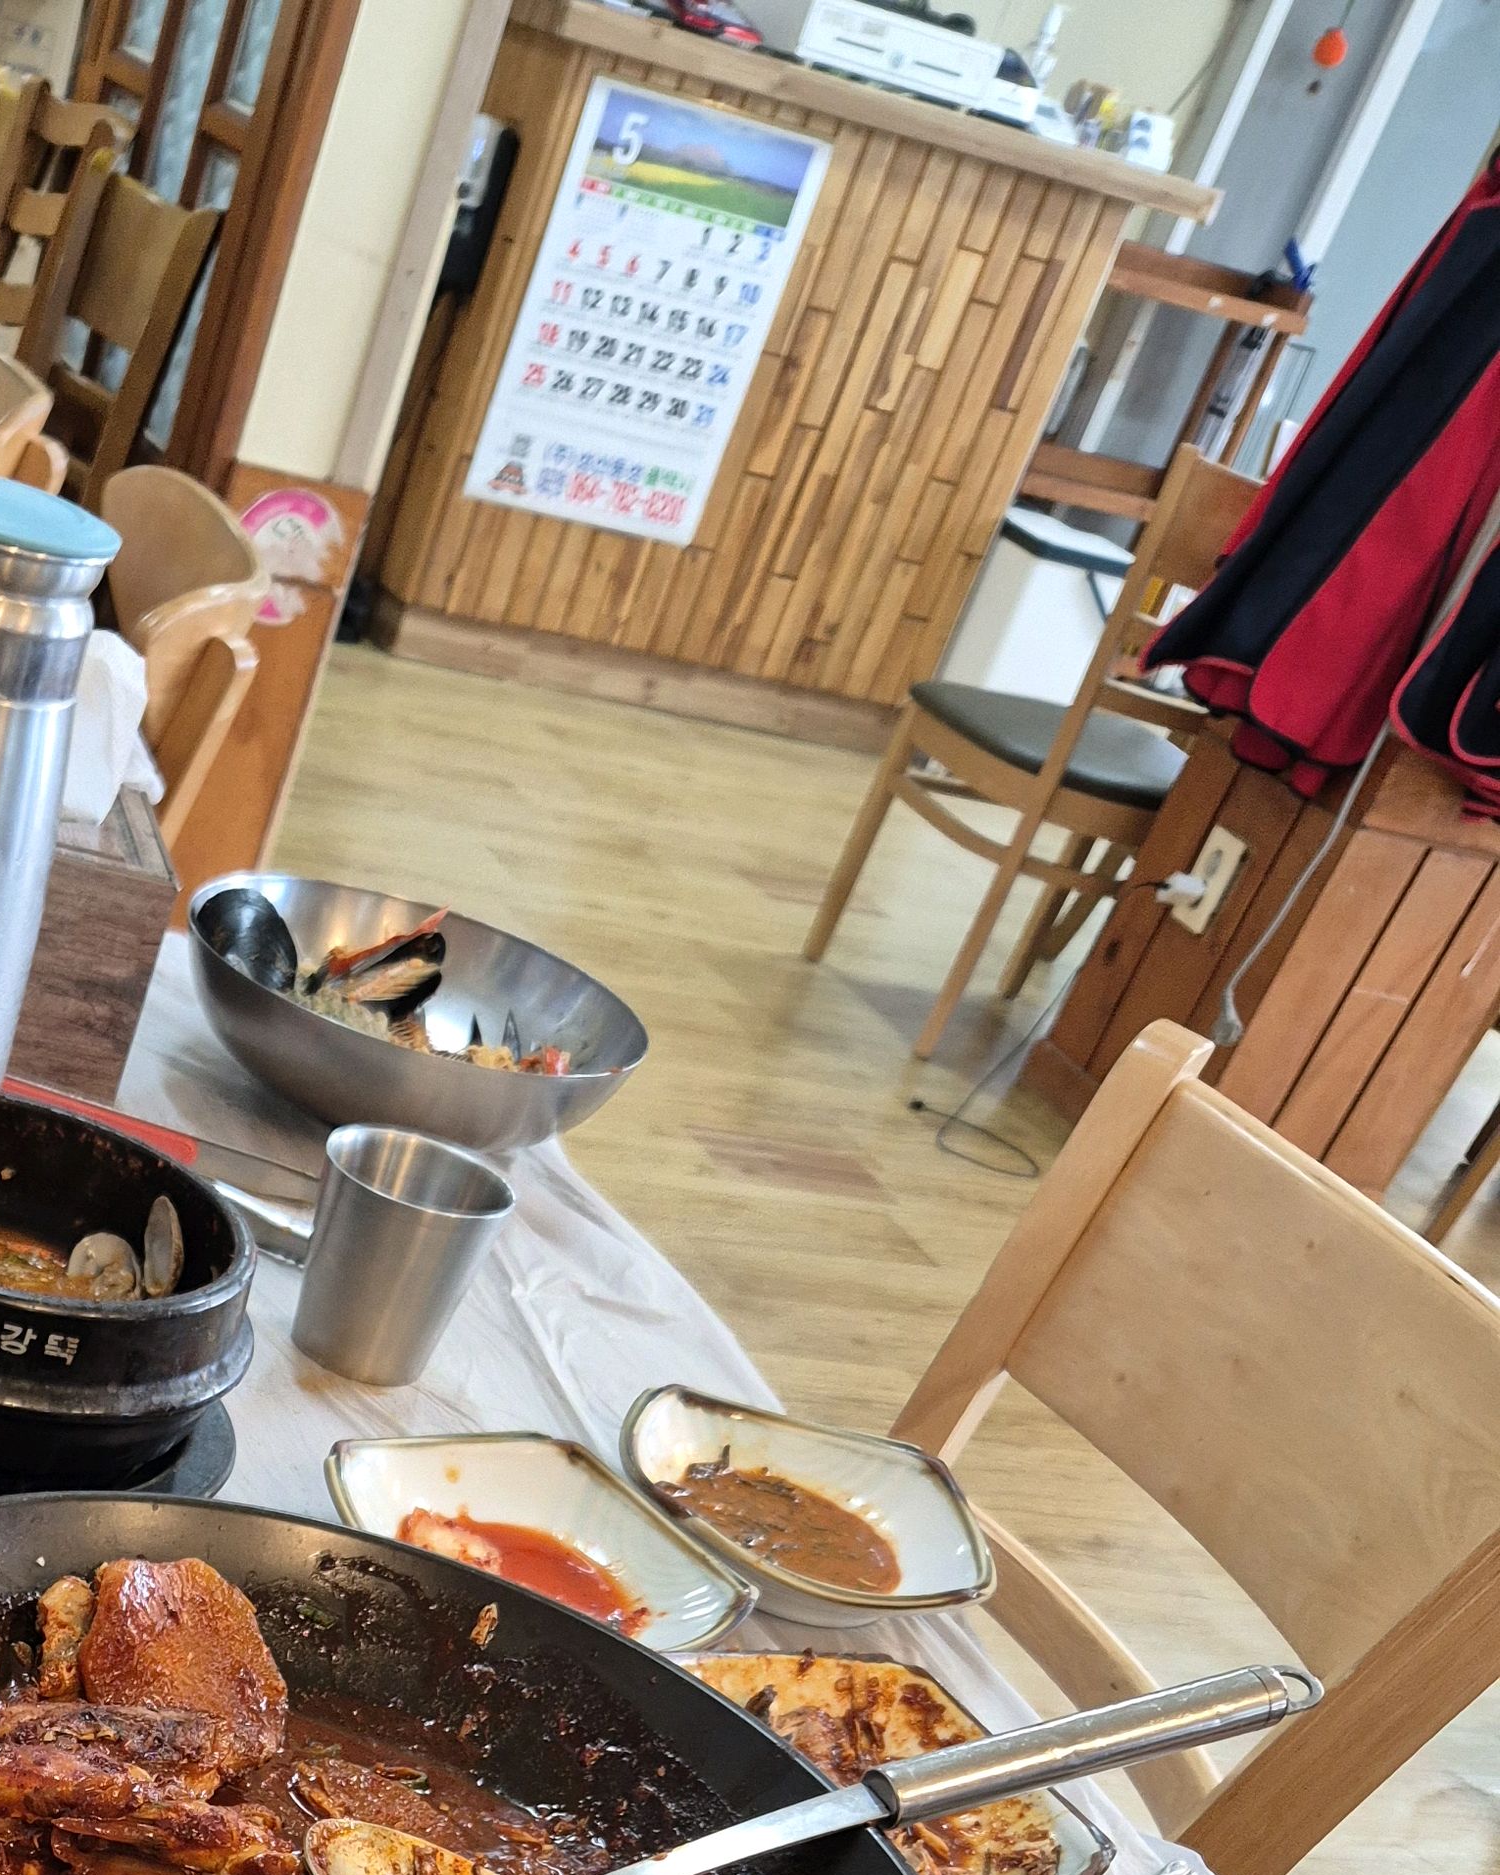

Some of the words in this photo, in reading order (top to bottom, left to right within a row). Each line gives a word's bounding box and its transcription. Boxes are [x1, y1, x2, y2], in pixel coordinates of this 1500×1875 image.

[613, 113, 650, 165] 5
[701, 227, 714, 246] 1
[726, 233, 743, 256] 2
[568, 239, 583, 261] 4
[597, 245, 612, 269] 5
[655, 259, 672, 283] 7
[714, 275, 729, 298] 9
[551, 279, 573, 304] 11
[581, 287, 605, 310] 12
[636, 301, 660, 325] 14
[666, 308, 690, 333] 15
[695, 316, 717, 339] 16
[722, 323, 748, 347] 17
[566, 328, 590, 352] 19
[591, 335, 619, 360] 20
[620, 342, 646, 368] 21
[649, 349, 676, 373] 22
[521, 362, 547, 388] 25
[551, 369, 576, 393] 26
[578, 376, 607, 401] 27
[636, 390, 662, 413] 29
